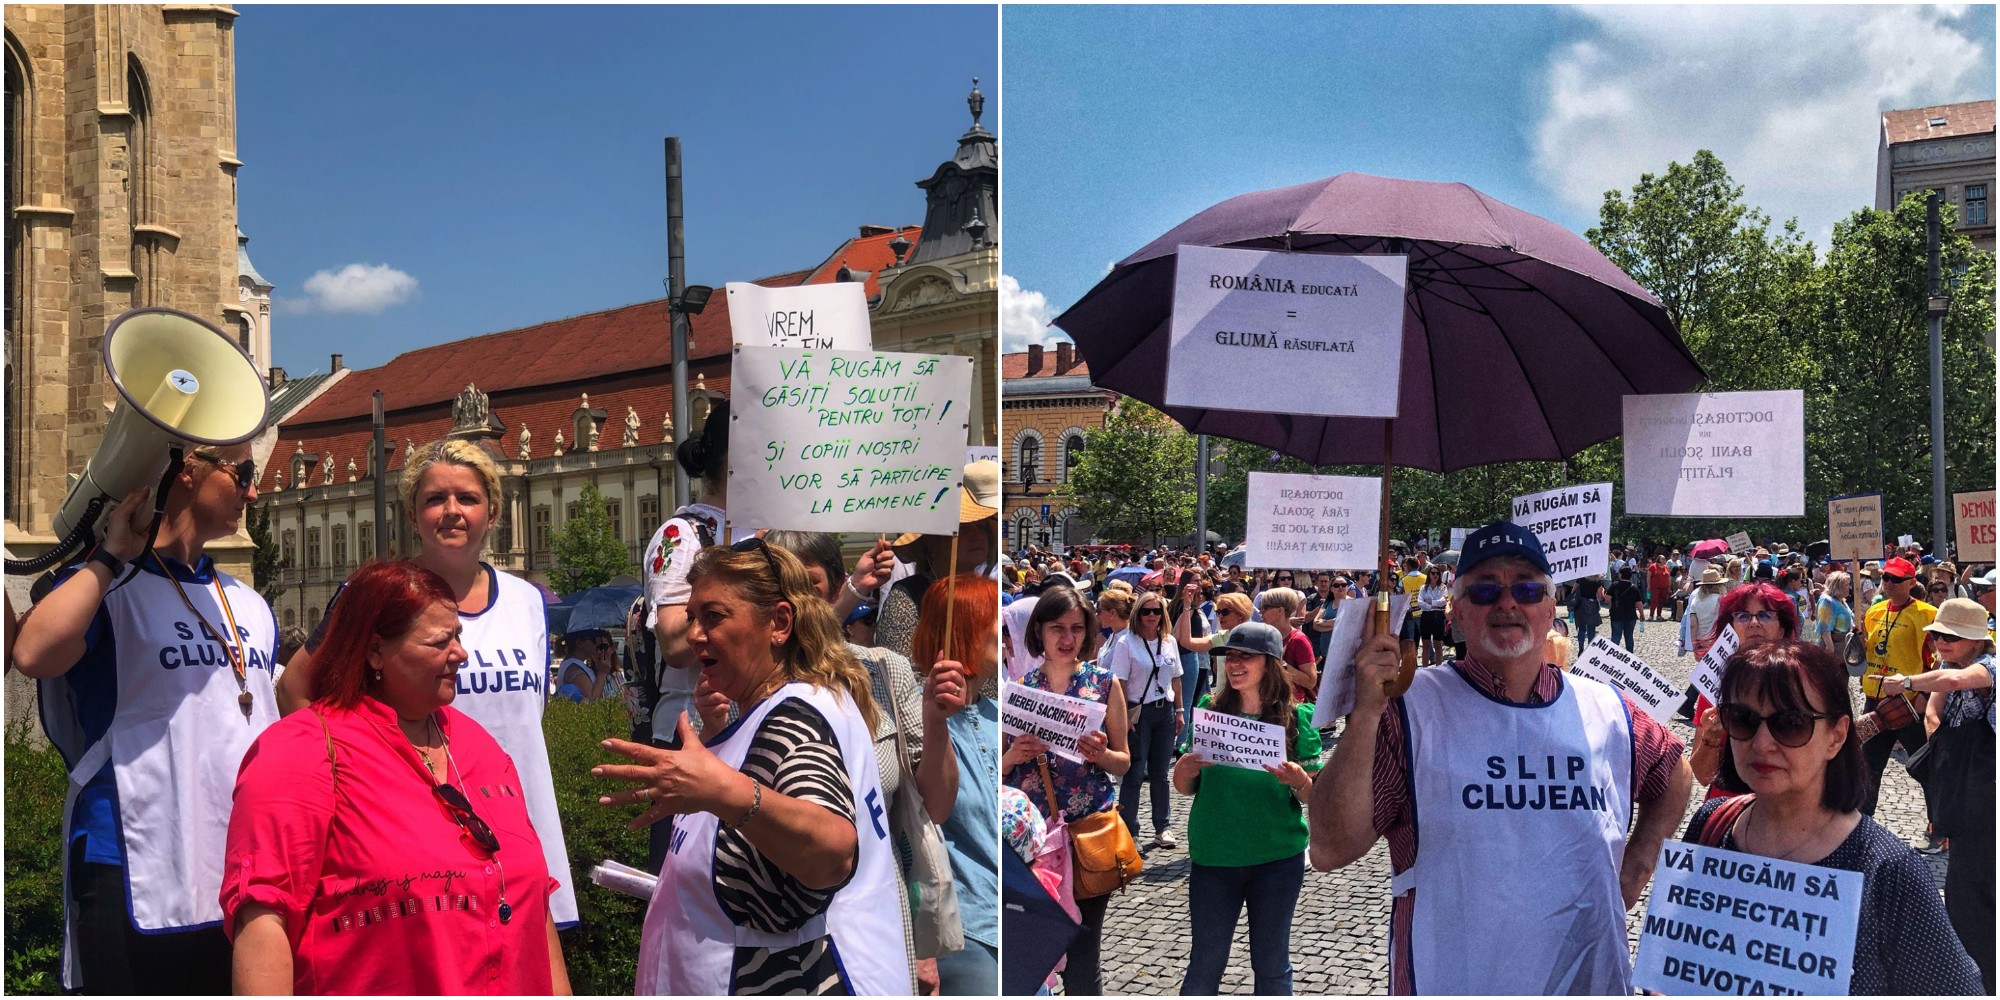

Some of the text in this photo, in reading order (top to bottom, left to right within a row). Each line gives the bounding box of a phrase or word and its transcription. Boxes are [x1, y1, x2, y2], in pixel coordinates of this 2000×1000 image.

[1209, 274, 1358, 297] ROMÂNIA EDUCATĂ
[1215, 331, 1355, 353] GLUMĂ RĂSUFLATĂ
[829, 356, 901, 378] RUGĂM
[913, 359, 940, 377] SĂ
[818, 408, 884, 427] PENTRU
[780, 473, 822, 490] VOR
[837, 469, 863, 488] SĂ
[810, 499, 833, 514] LA
[1514, 488, 1601, 517] VĂ RUGĂM SĂ
[1961, 500, 1996, 518] DEMNI
[1560, 532, 1603, 551] CELOR
[1550, 555, 1588, 574] OTAȚI!
[1723, 628, 1734, 644] VĂ
[1605, 647, 1631, 664] poate
[1630, 660, 1642, 672] să
[1640, 666, 1653, 680] fie
[456, 670, 541, 696] LUJEAN
[1589, 656, 1600, 667] de
[1600, 663, 1626, 681] măriri
[1623, 677, 1660, 708] salariale!
[1007, 692, 1037, 713] MEREU
[1002, 711, 1037, 735] ICIODATĂ
[1203, 712, 1266, 733] MILIOANE
[1194, 723, 1279, 748] SUNT TOCATE
[1193, 737, 1280, 758] PE PROGRAME
[1462, 783, 1608, 812] CLUJEAN
[1664, 848, 1839, 900] VĂ RUGĂM SĂ
[1667, 884, 1828, 942] RESPECTAȚI
[1644, 914, 1838, 980] MUNCA CELOR
